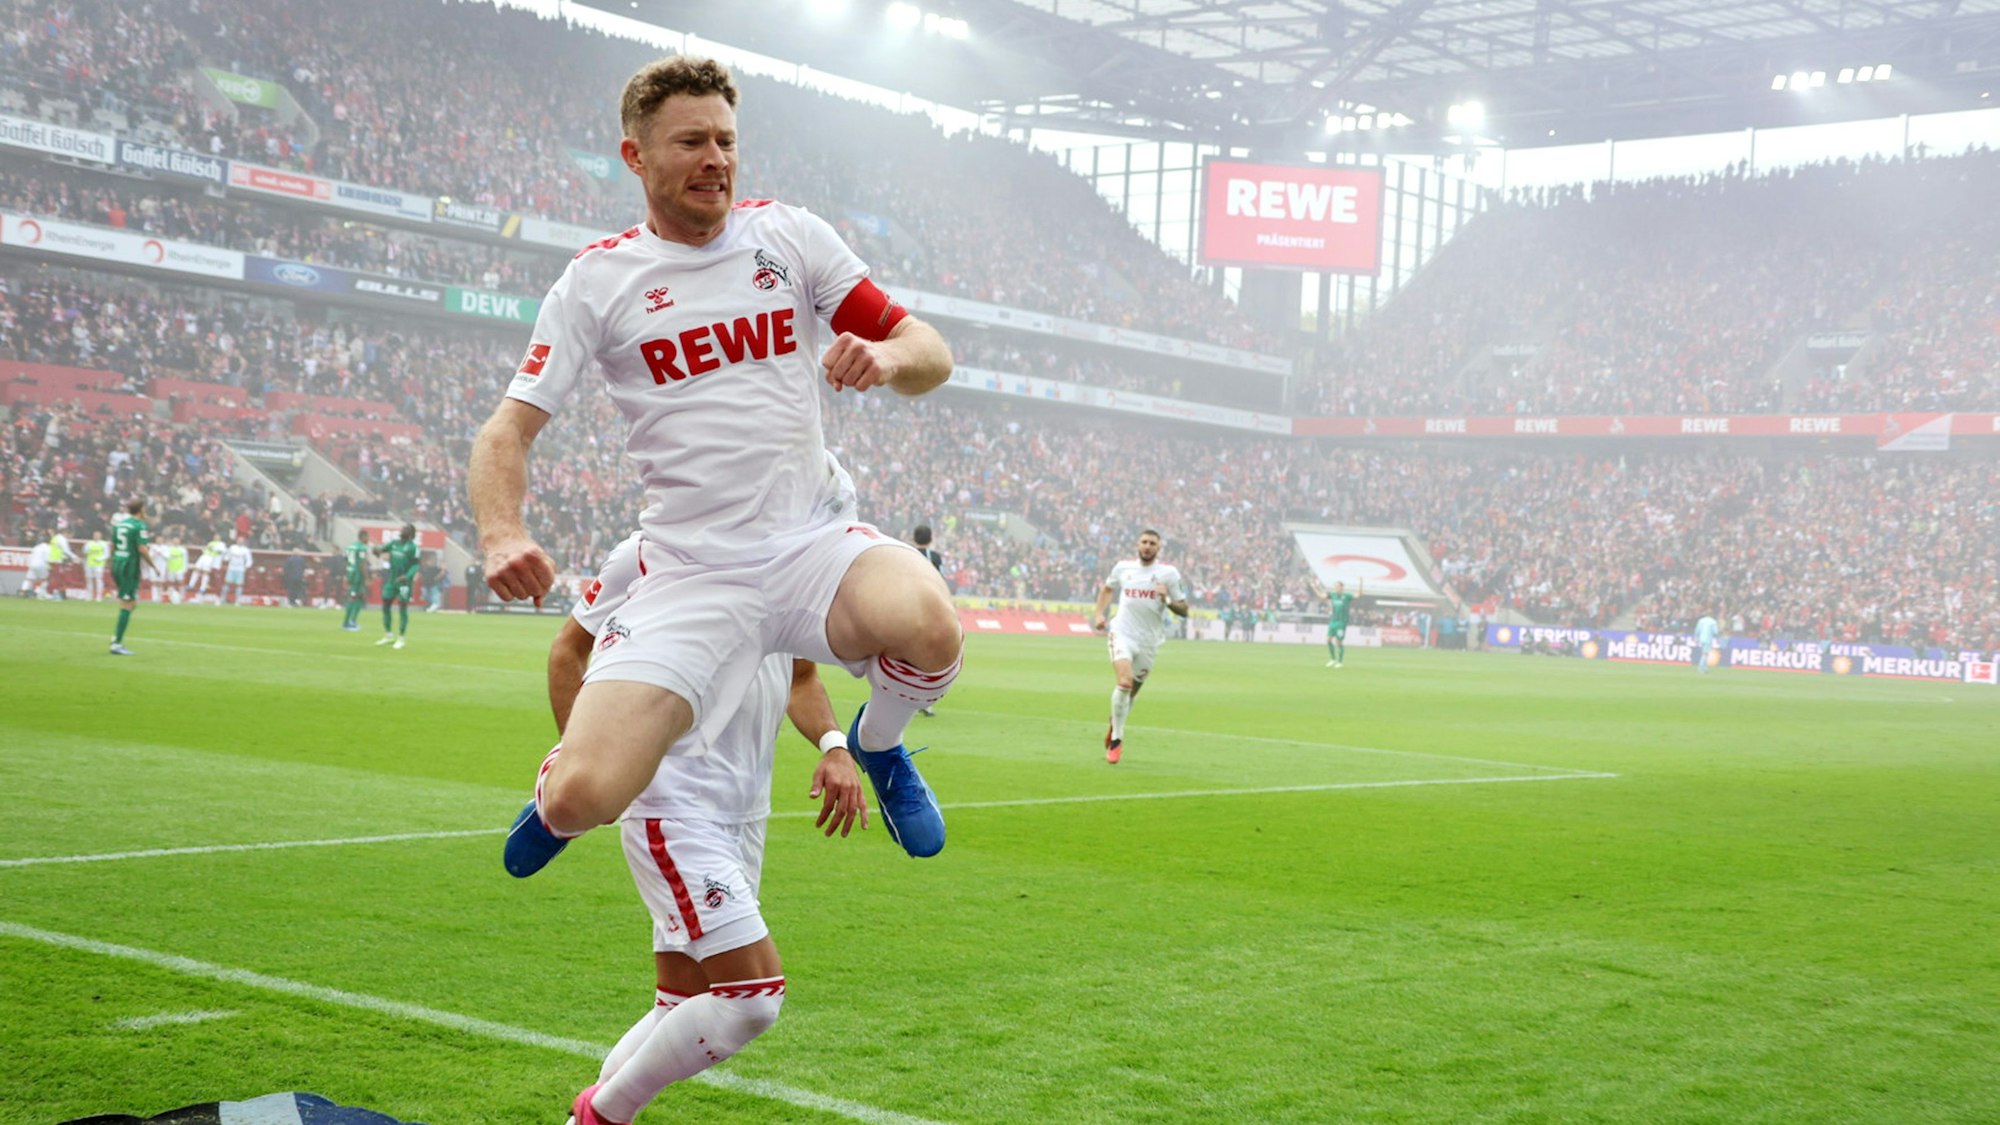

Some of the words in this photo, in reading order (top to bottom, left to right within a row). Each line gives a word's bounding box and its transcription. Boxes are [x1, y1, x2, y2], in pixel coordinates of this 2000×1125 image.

[122, 143, 168, 171] Gaffel
[171, 153, 222, 181] Kölsch
[1227, 178, 1358, 223] REWE
[1257, 232, 1326, 249] PRÄSENTIERT
[461, 290, 521, 319] DEVK
[646, 299, 675, 314] hummel
[640, 308, 797, 385] REWE
[1425, 418, 1467, 433] REWE
[1515, 418, 1558, 433] REWE
[1681, 418, 1729, 433] REWE
[1789, 417, 1841, 433] REWE
[117, 527, 129, 550] 5
[1124, 588, 1157, 600] REWE
[1607, 641, 1692, 662] MERKUR
[1731, 648, 1822, 670] MERKUR
[1863, 657, 1961, 678] MERKUR
